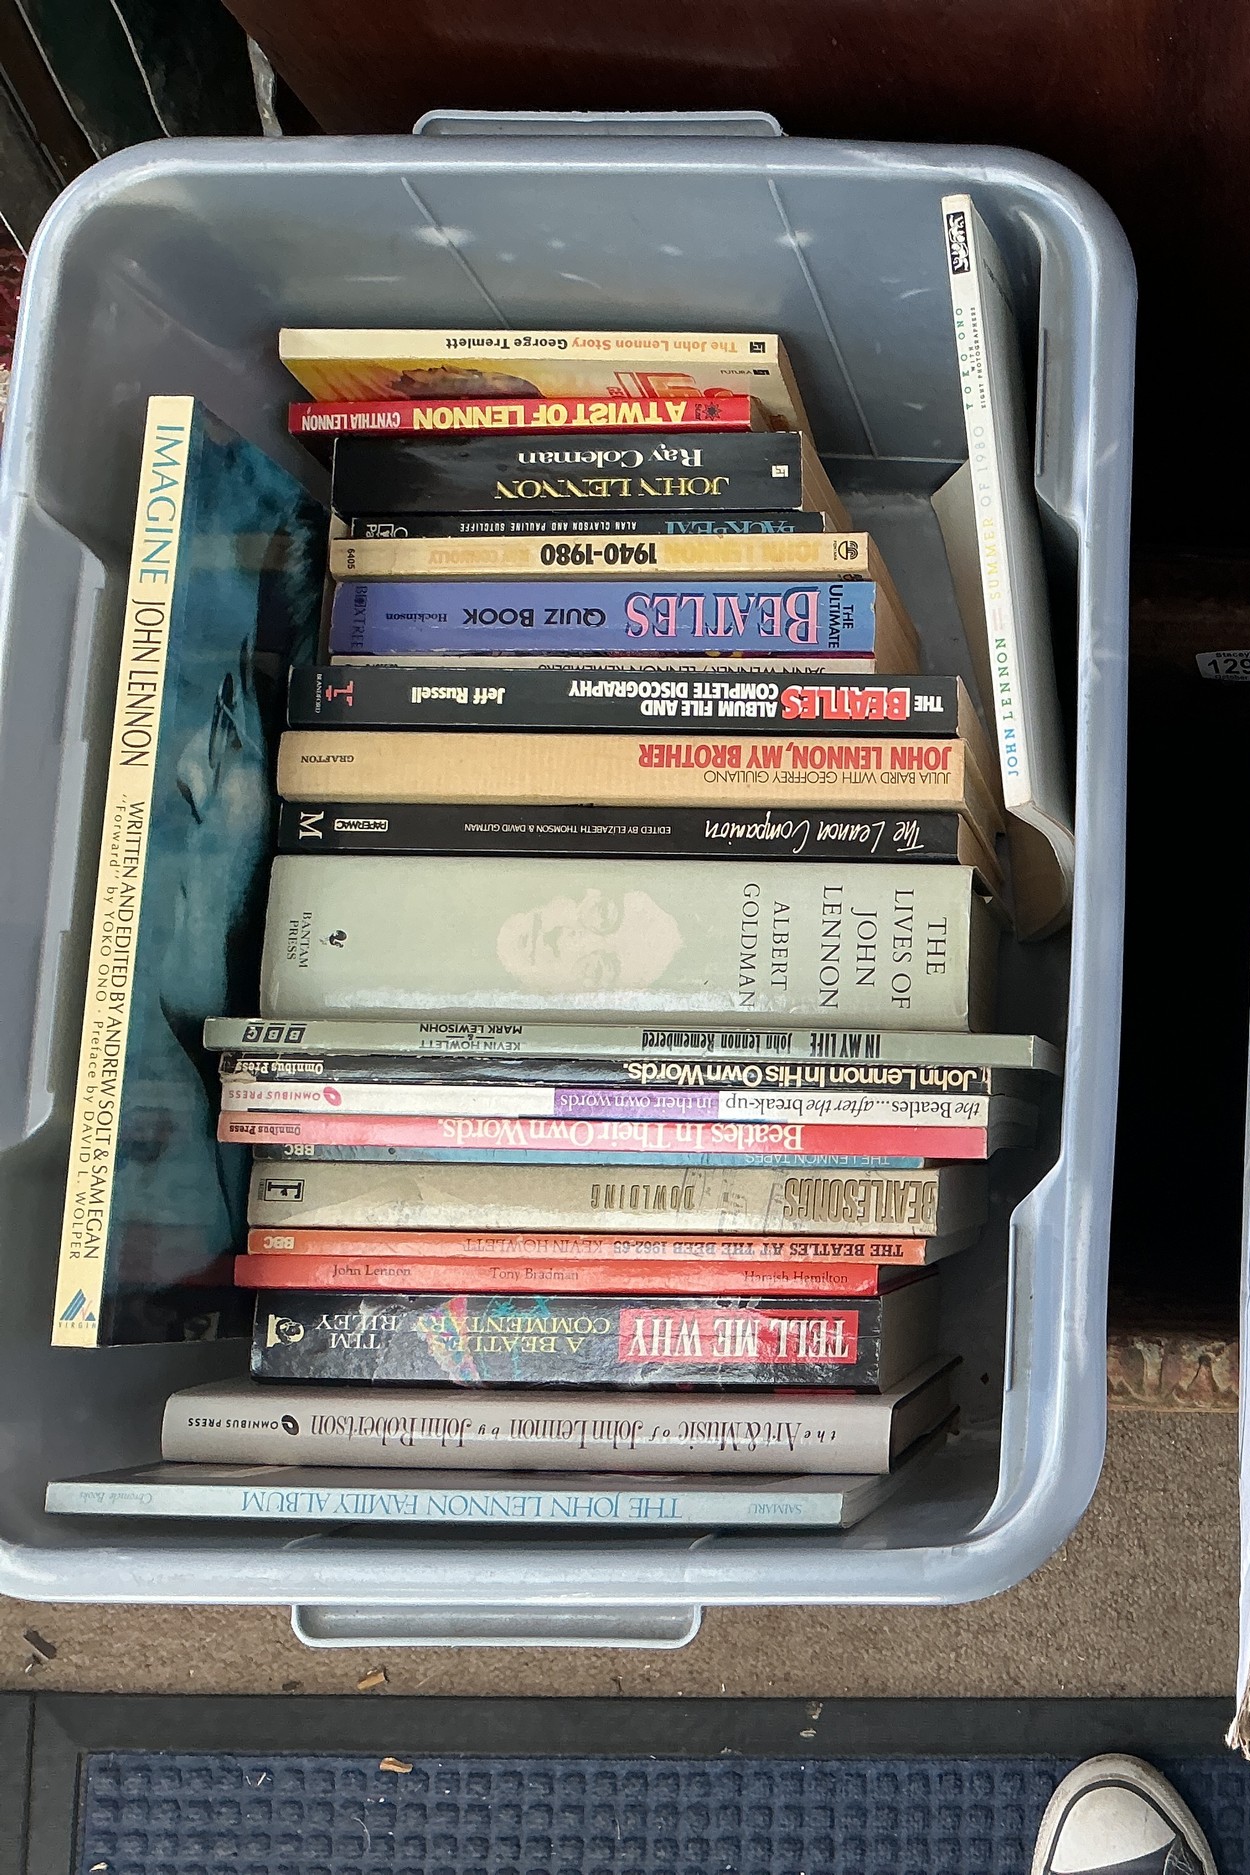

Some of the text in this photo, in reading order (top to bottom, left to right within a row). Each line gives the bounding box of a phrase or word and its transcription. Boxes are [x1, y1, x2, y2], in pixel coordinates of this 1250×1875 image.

[445, 336, 567, 350] George Tremlett
[571, 337, 736, 353] The John Lennon Story
[300, 411, 400, 430] CYNTHIA LENNON
[411, 401, 686, 429] A TWIST OF LENNON
[518, 444, 702, 468] Ray Coleman
[494, 476, 728, 499] JOHN LENNON
[540, 542, 657, 566] 1940-1980
[119, 425, 184, 768] IMAGINE JOHN LENNON
[385, 612, 447, 623] Hockinson
[463, 587, 820, 646] BEATLES QUIZ BOOK
[410, 686, 504, 704] Jeff Russell
[568, 680, 777, 699] COMPLETE DISCOGRAPHY
[781, 686, 943, 720] THE BEATLES
[640, 699, 777, 718] ALBUM FILE AND
[995, 637, 1019, 776] JOHN LENNON
[299, 754, 354, 763] GRAFTON
[638, 741, 951, 771] JOHN LENNON, MY BROTHER
[702, 770, 950, 783] JULIA BAIRD WITH GEOFFREY GIULIANO
[335, 820, 385, 829] PAPERMAC
[703, 811, 923, 851] The Lennon Companion
[286, 920, 298, 961] PRESS
[299, 912, 311, 969] BANTAM
[738, 883, 760, 1008] GOLDMAN
[770, 903, 788, 990] ALBERT
[820, 886, 842, 1008] LENNON
[851, 908, 876, 986] JOHN
[892, 889, 912, 1009] LIVES OF
[925, 918, 946, 975] THE
[419, 1023, 522, 1034] MARK LEWISOHN
[418, 1039, 520, 1051] KEVIN HOWLETT
[623, 1062, 978, 1092] John Lennon In His Own Words.
[781, 1175, 936, 1226] BEATLESONGS
[629, 1318, 849, 1359] TELL ME WHY
[185, 1418, 278, 1431] OMNIBUS PRESS
[239, 1490, 681, 1519] THE JOHN LENNON FAMILY ALBUM
